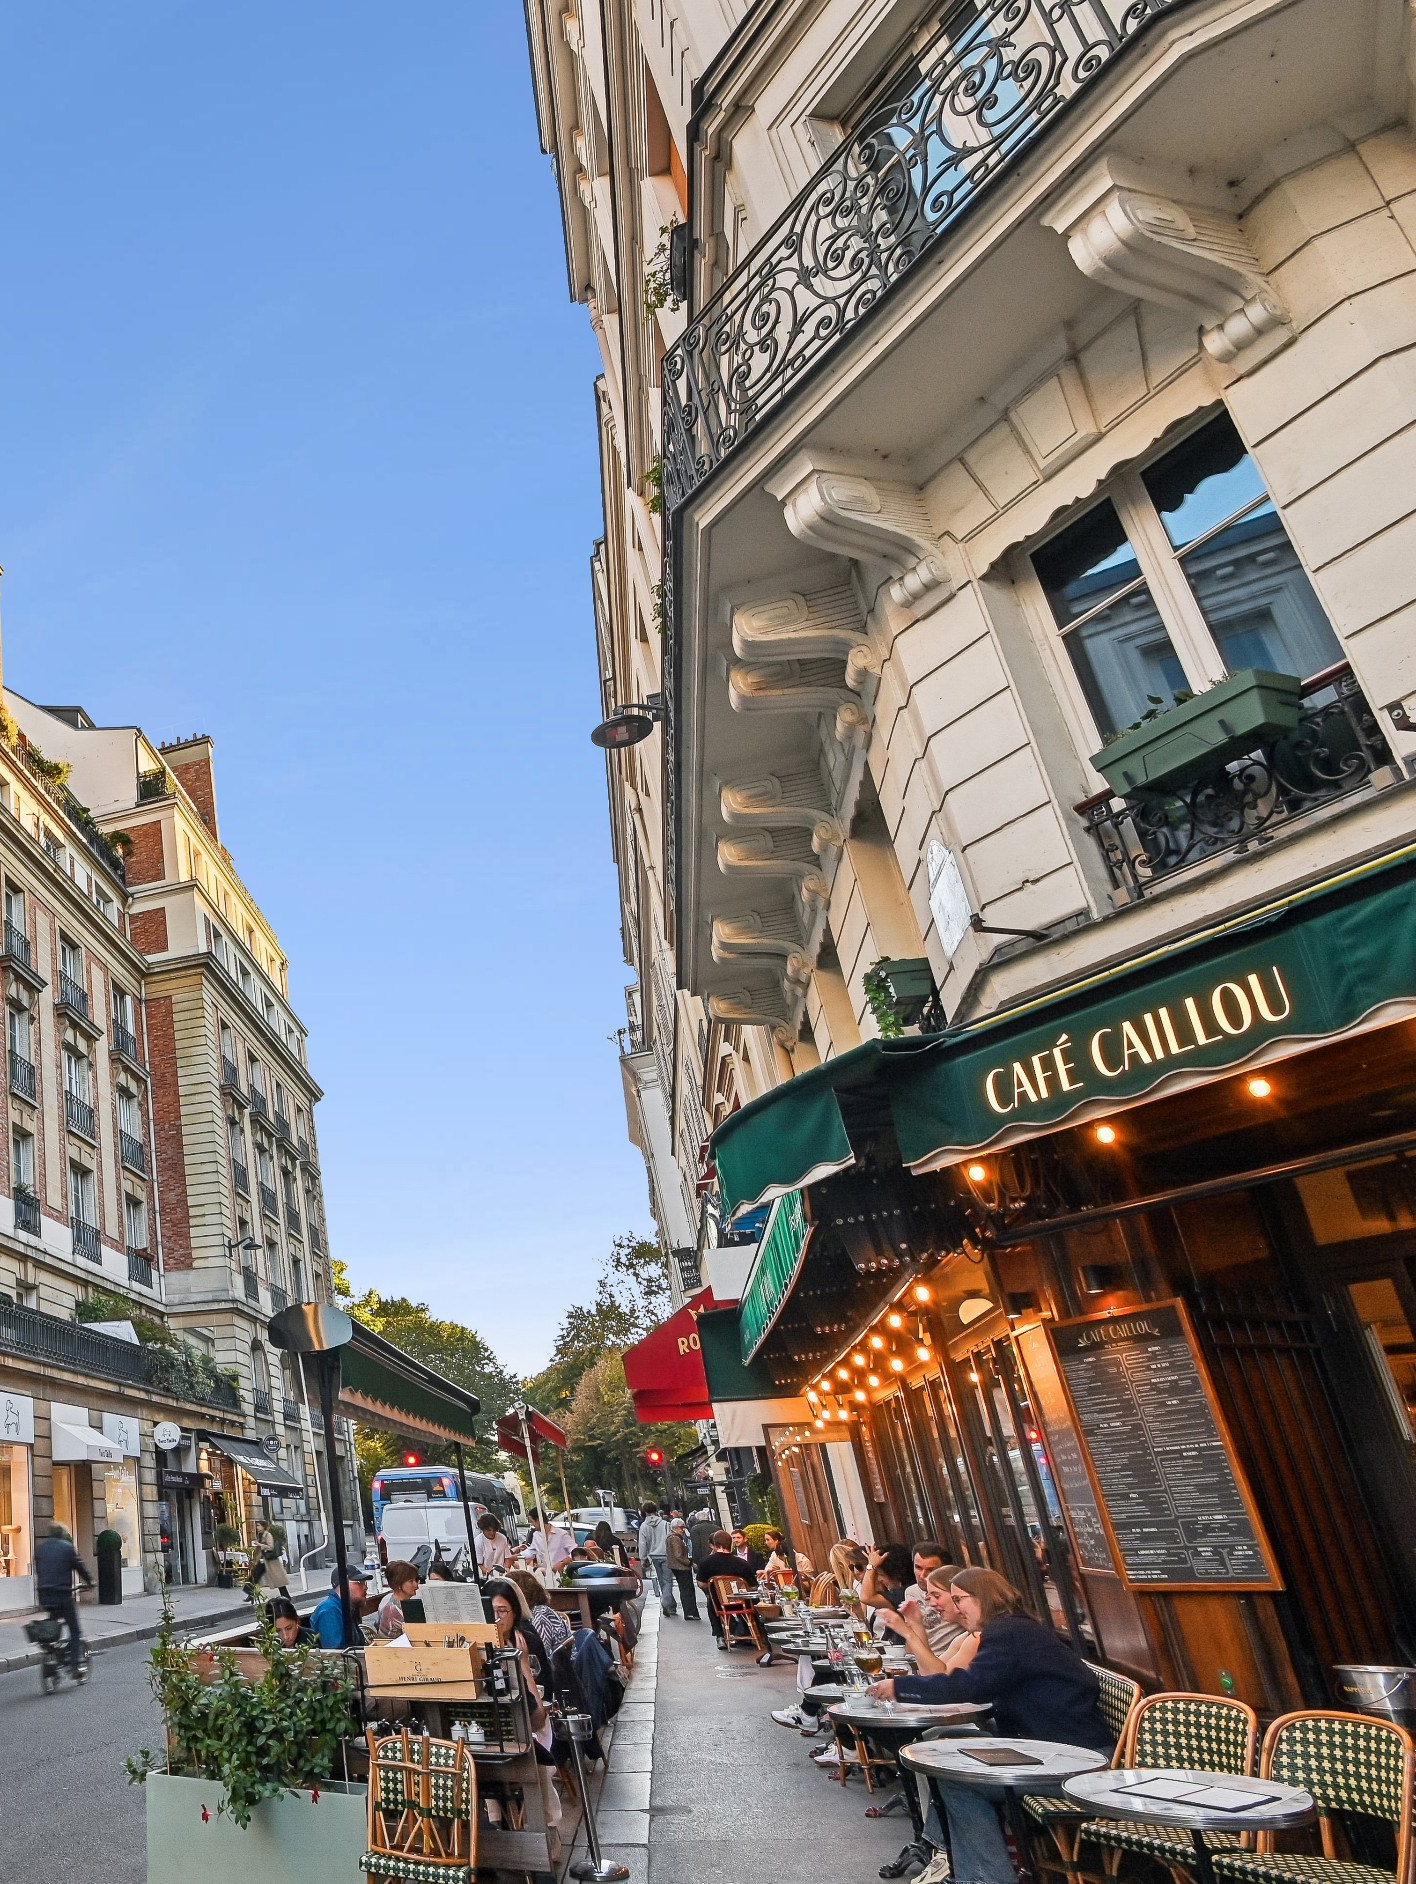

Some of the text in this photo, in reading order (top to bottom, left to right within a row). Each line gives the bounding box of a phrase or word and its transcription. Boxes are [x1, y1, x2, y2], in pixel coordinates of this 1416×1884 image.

[985, 965, 1291, 1114] CAFÉ CAILLOU
[1109, 1320, 1153, 1339] CAILLOU
